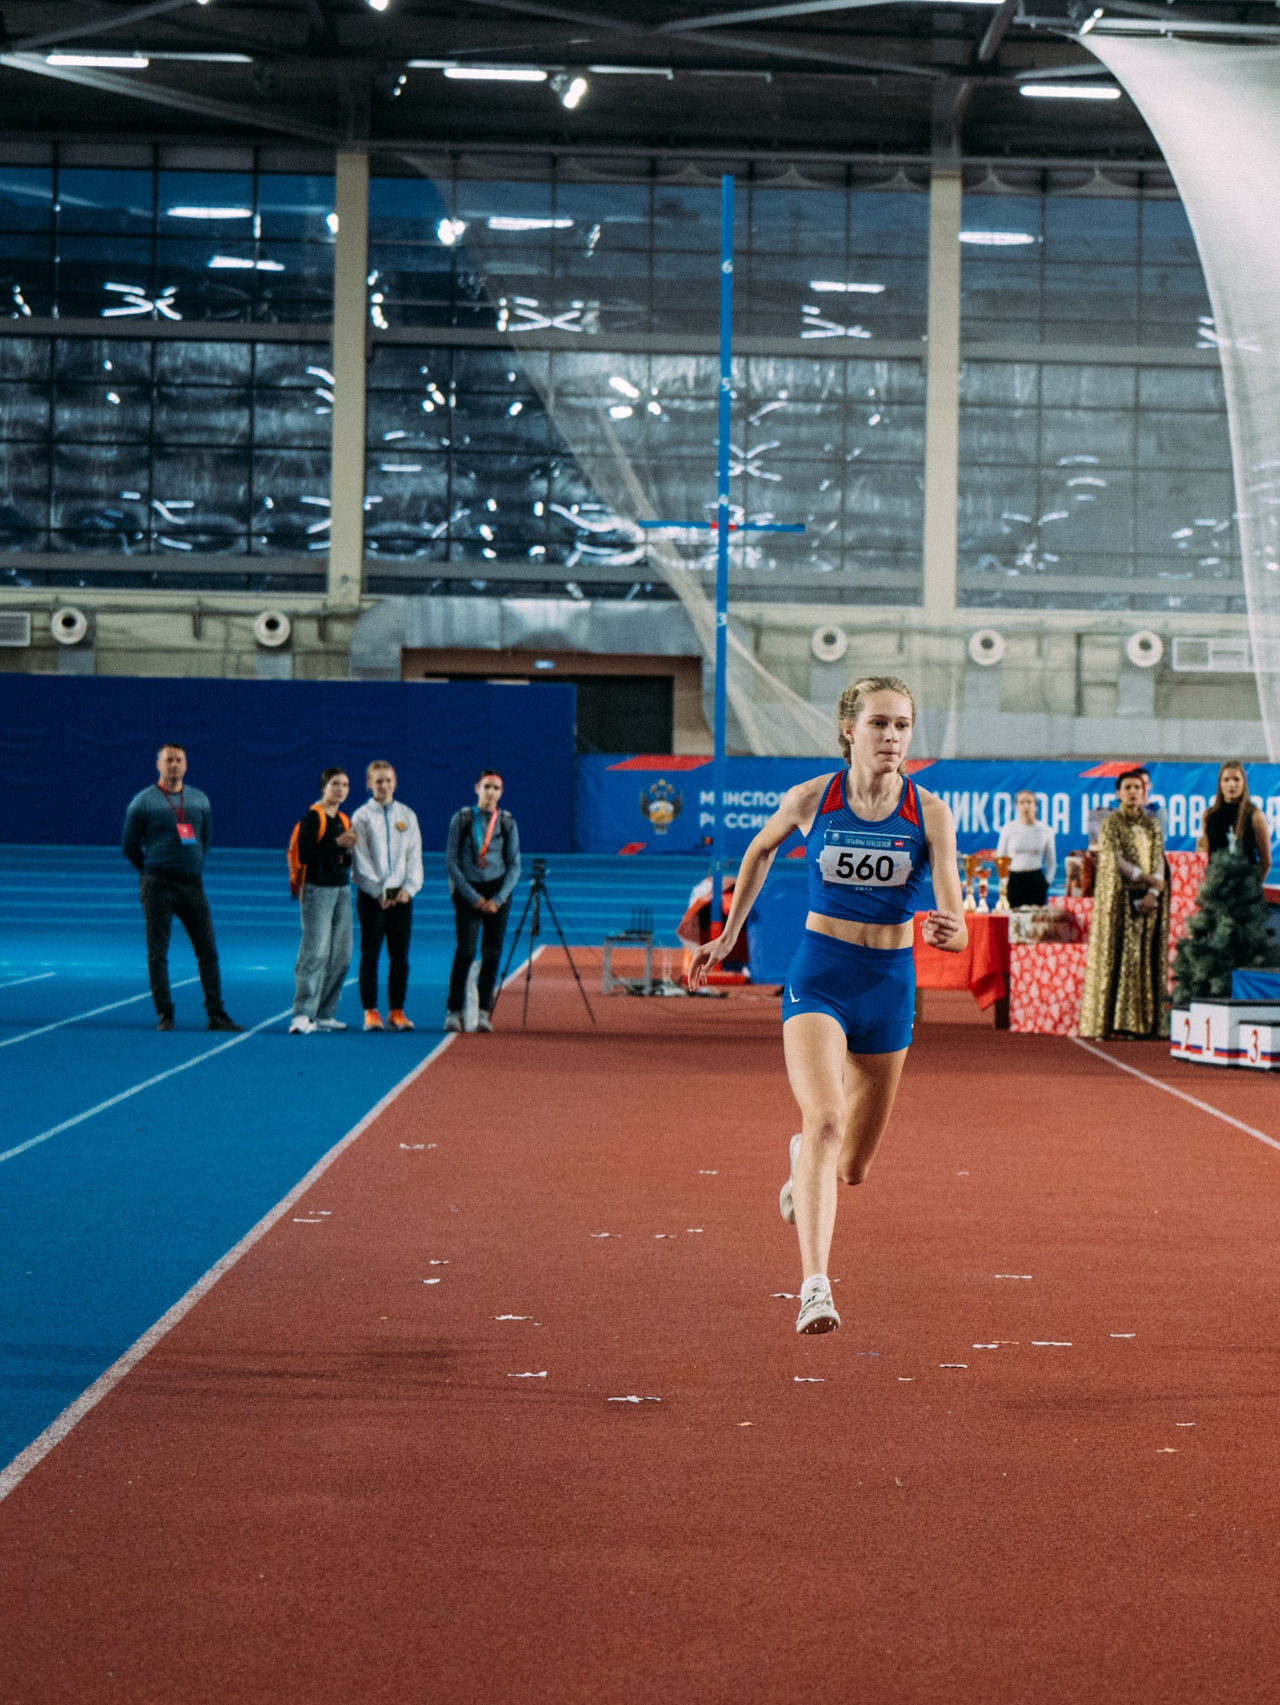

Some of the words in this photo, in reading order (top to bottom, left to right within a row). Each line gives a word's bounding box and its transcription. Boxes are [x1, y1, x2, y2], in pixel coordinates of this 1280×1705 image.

[836, 852, 894, 882] 560
[1184, 1018, 1191, 1051] 2
[1205, 1017, 1211, 1051] 1
[1250, 1029, 1259, 1063] 3
